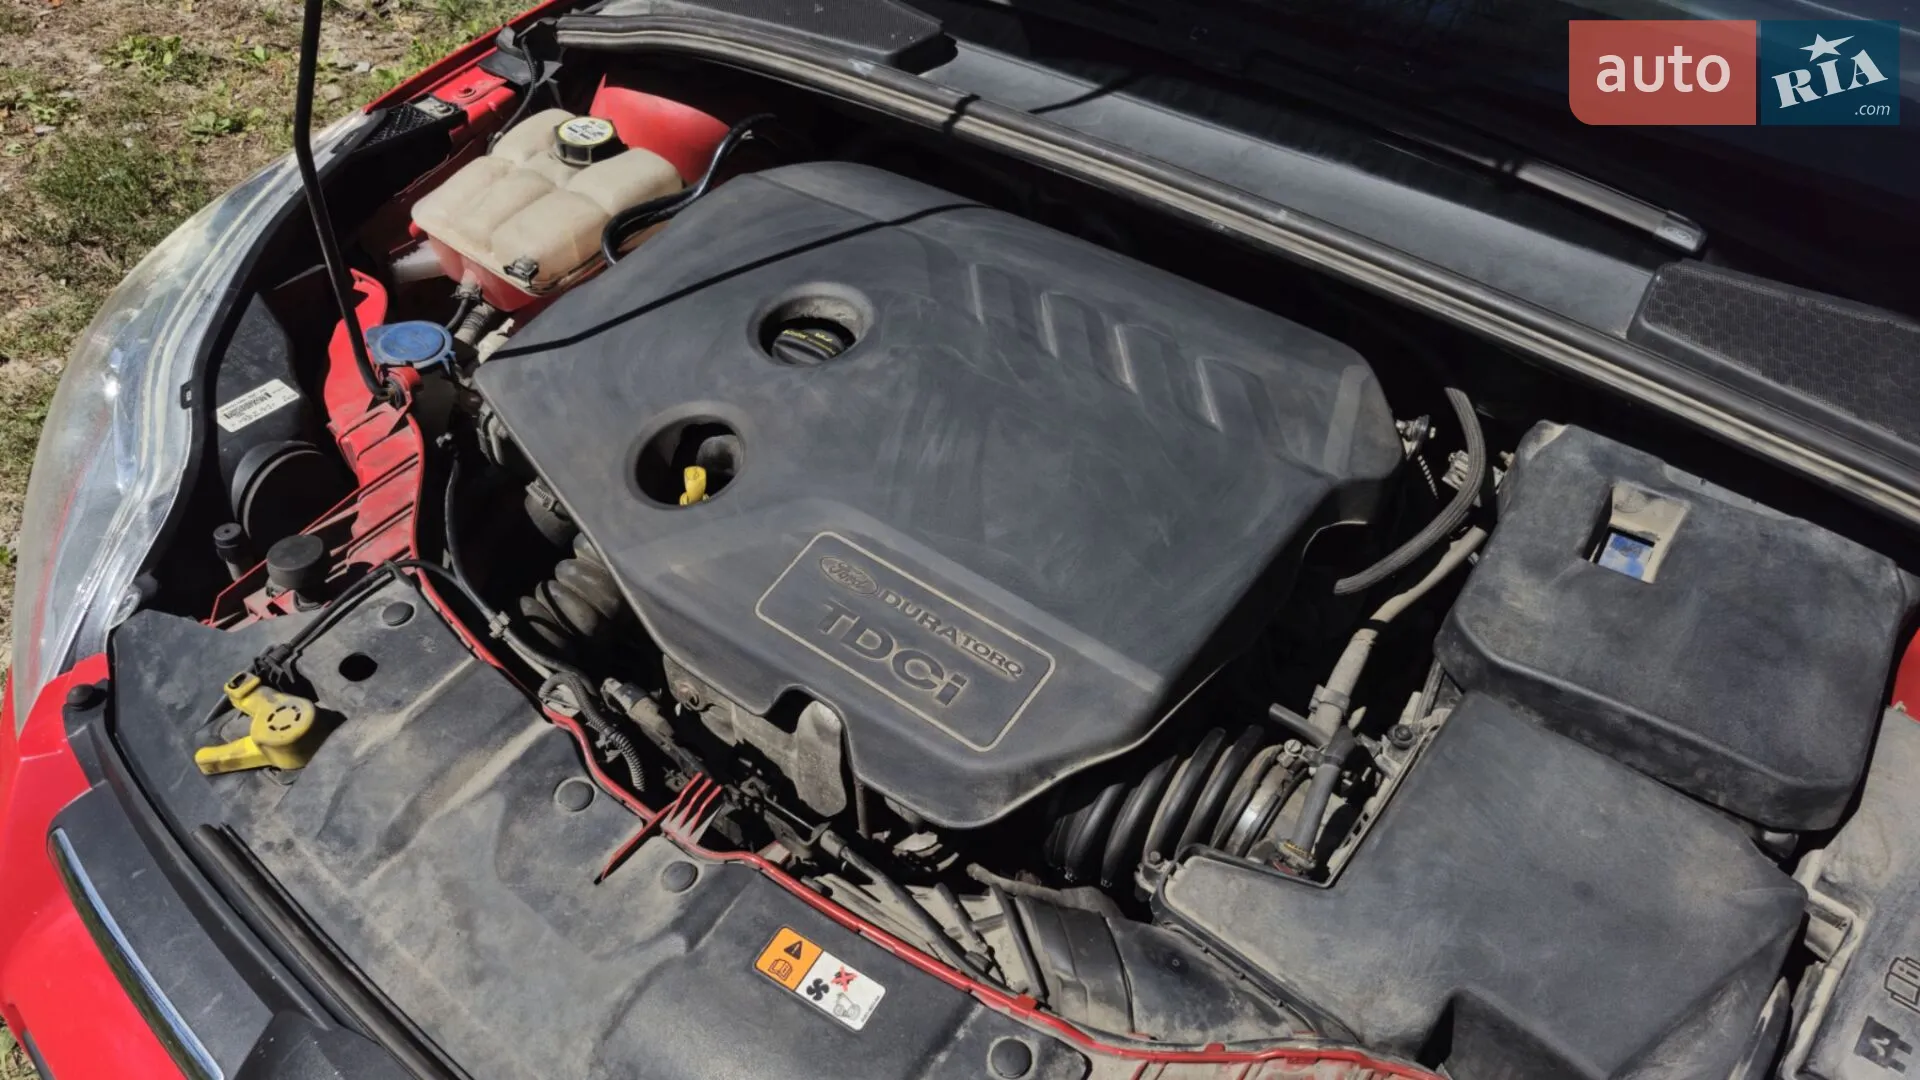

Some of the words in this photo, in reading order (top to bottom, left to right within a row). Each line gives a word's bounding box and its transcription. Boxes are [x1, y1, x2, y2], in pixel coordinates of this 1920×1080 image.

[817, 600, 969, 706] TDCi
[826, 559, 872, 592] Ford
[879, 589, 1024, 678] DURATORQ
